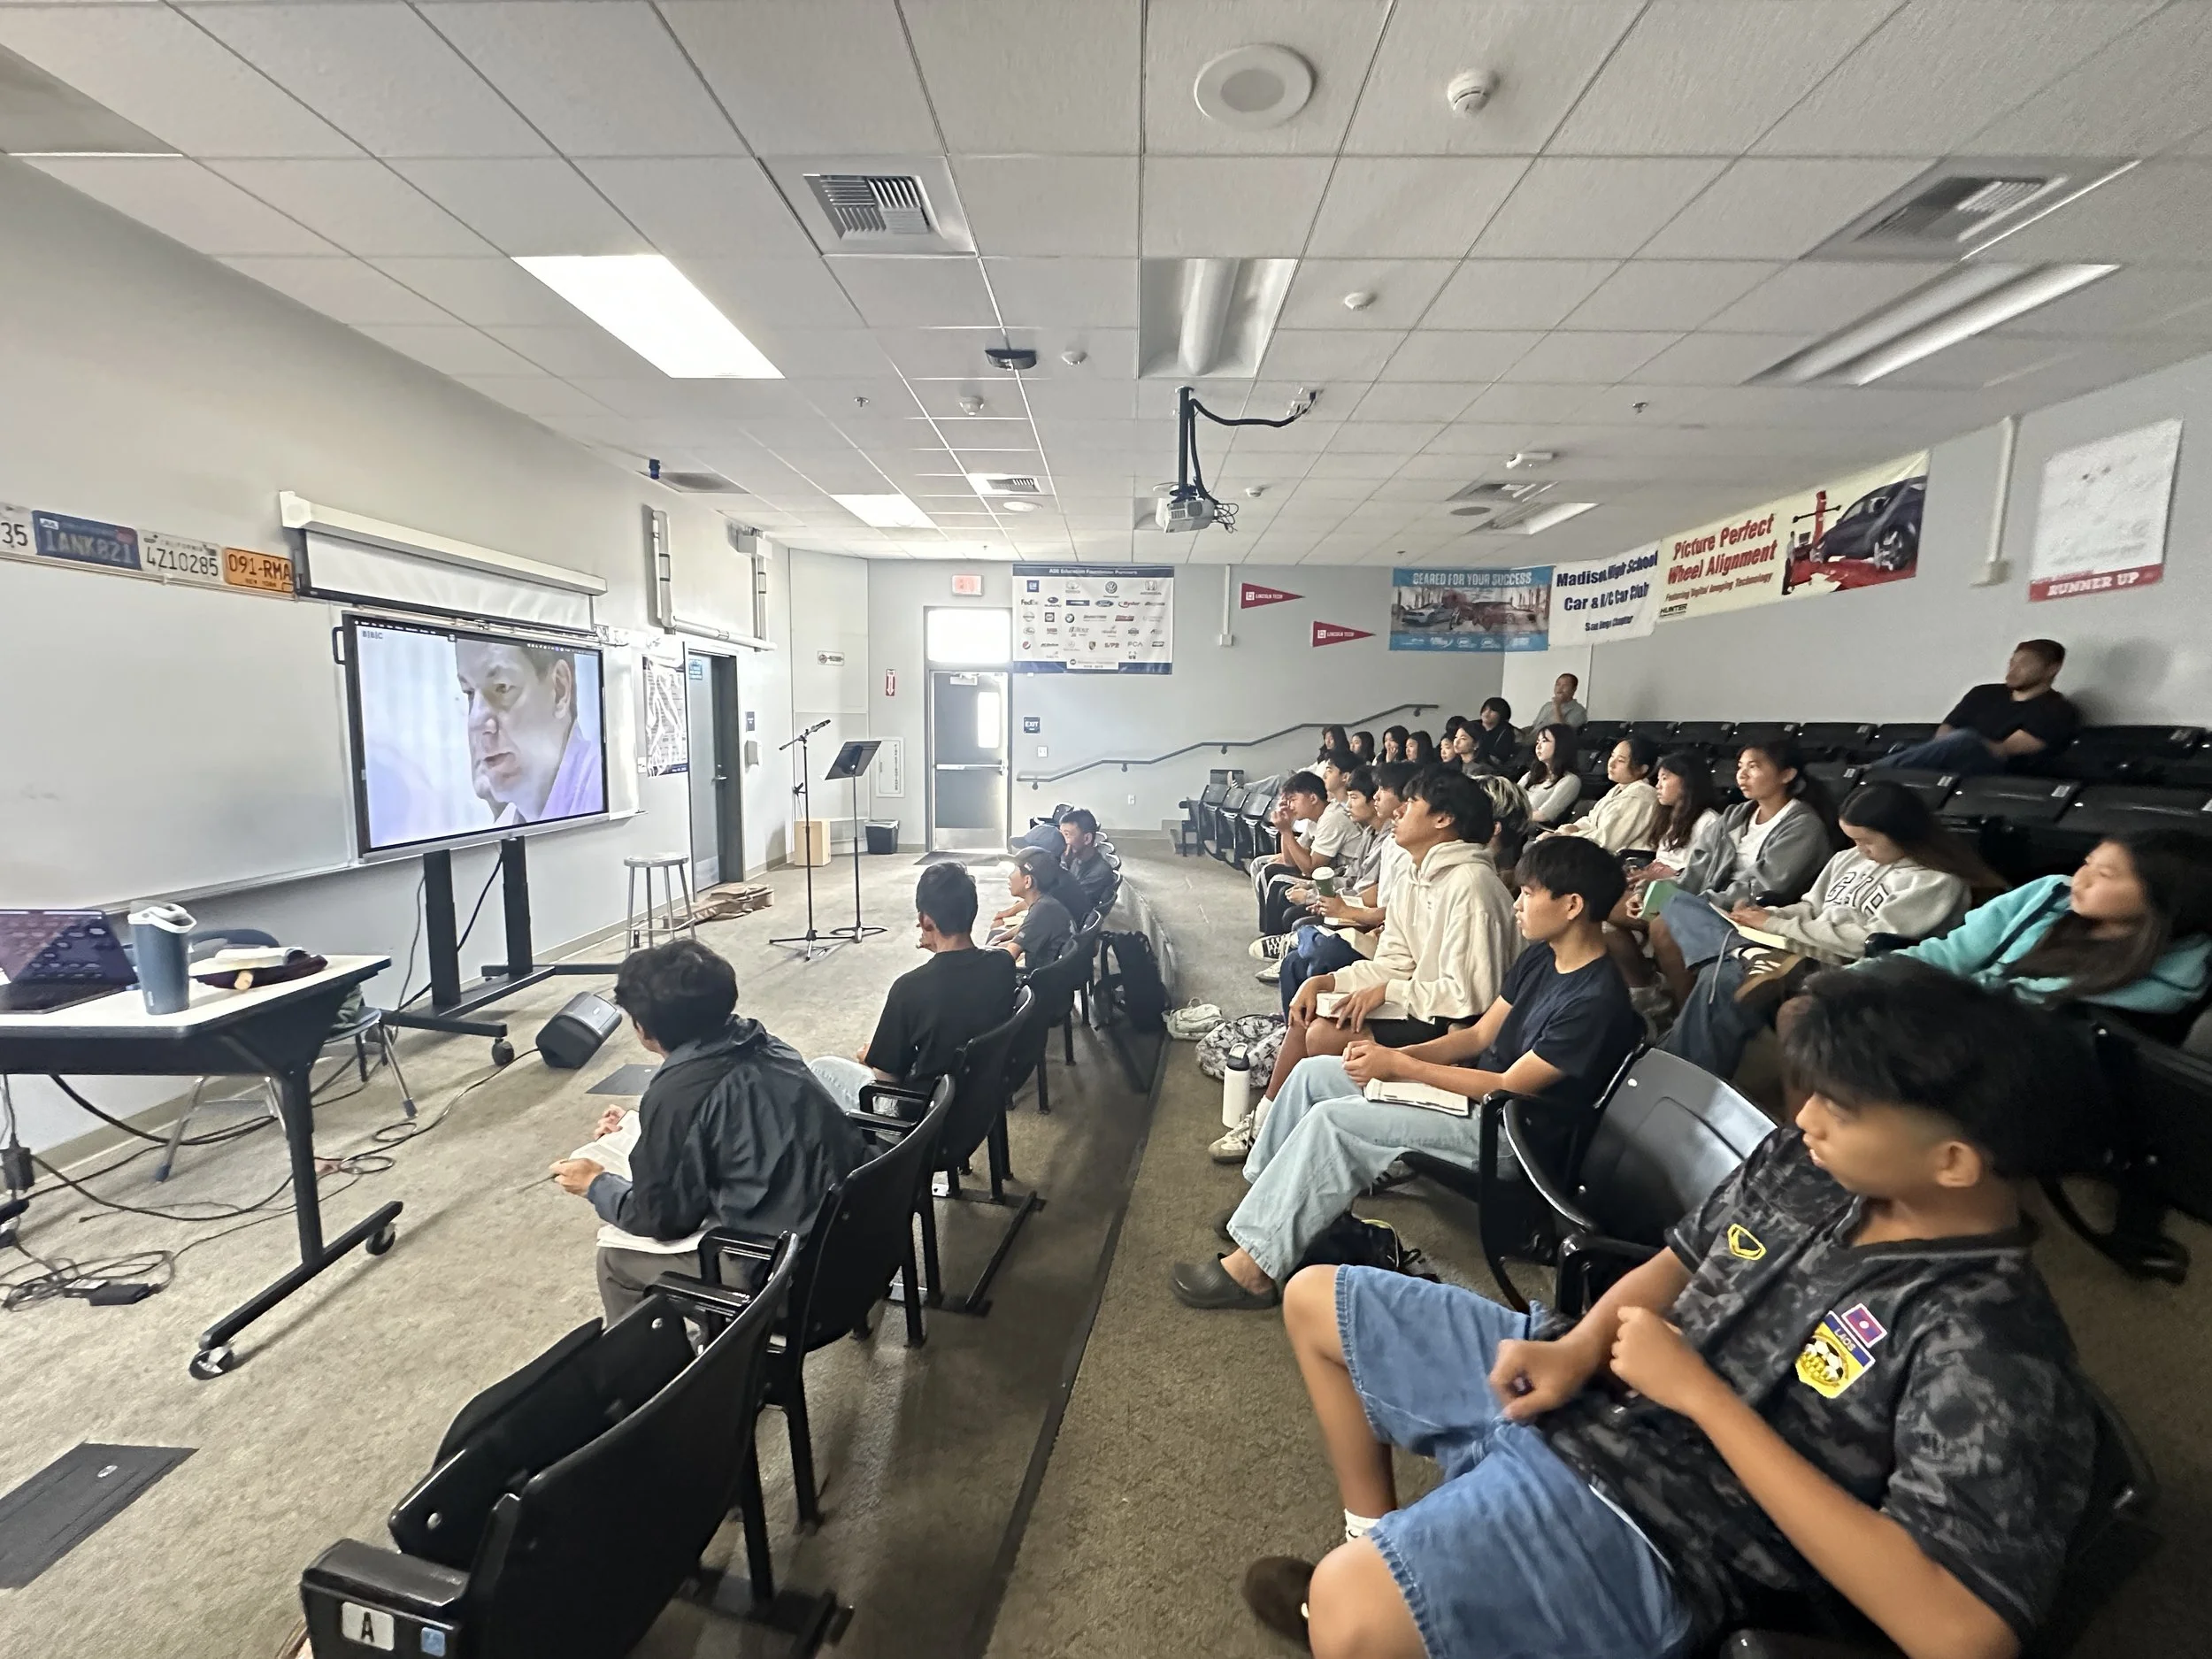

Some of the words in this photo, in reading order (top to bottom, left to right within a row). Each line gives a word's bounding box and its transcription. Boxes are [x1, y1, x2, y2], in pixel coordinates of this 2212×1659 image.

[1673, 535, 1716, 561] Picture
[1720, 513, 1775, 548] Perfect
[146, 546, 219, 577] 4Z10285
[227, 553, 293, 581] 091-RMA
[1668, 559, 1704, 585] Wheel
[1705, 540, 1778, 577] Alignment
[1413, 572, 1446, 585] GEARED
[1448, 573, 1465, 586] FOR
[1467, 573, 1491, 586] YOUR
[1492, 572, 1532, 586] SUCCESS
[2047, 576, 2113, 596] RUNNER
[2116, 572, 2139, 586] UP
[1563, 596, 1589, 611] Car
[1591, 596, 1599, 610] &
[1615, 589, 1630, 604] Car
[1660, 603, 1688, 614] HUNTER
[361, 1611, 374, 1643] A
